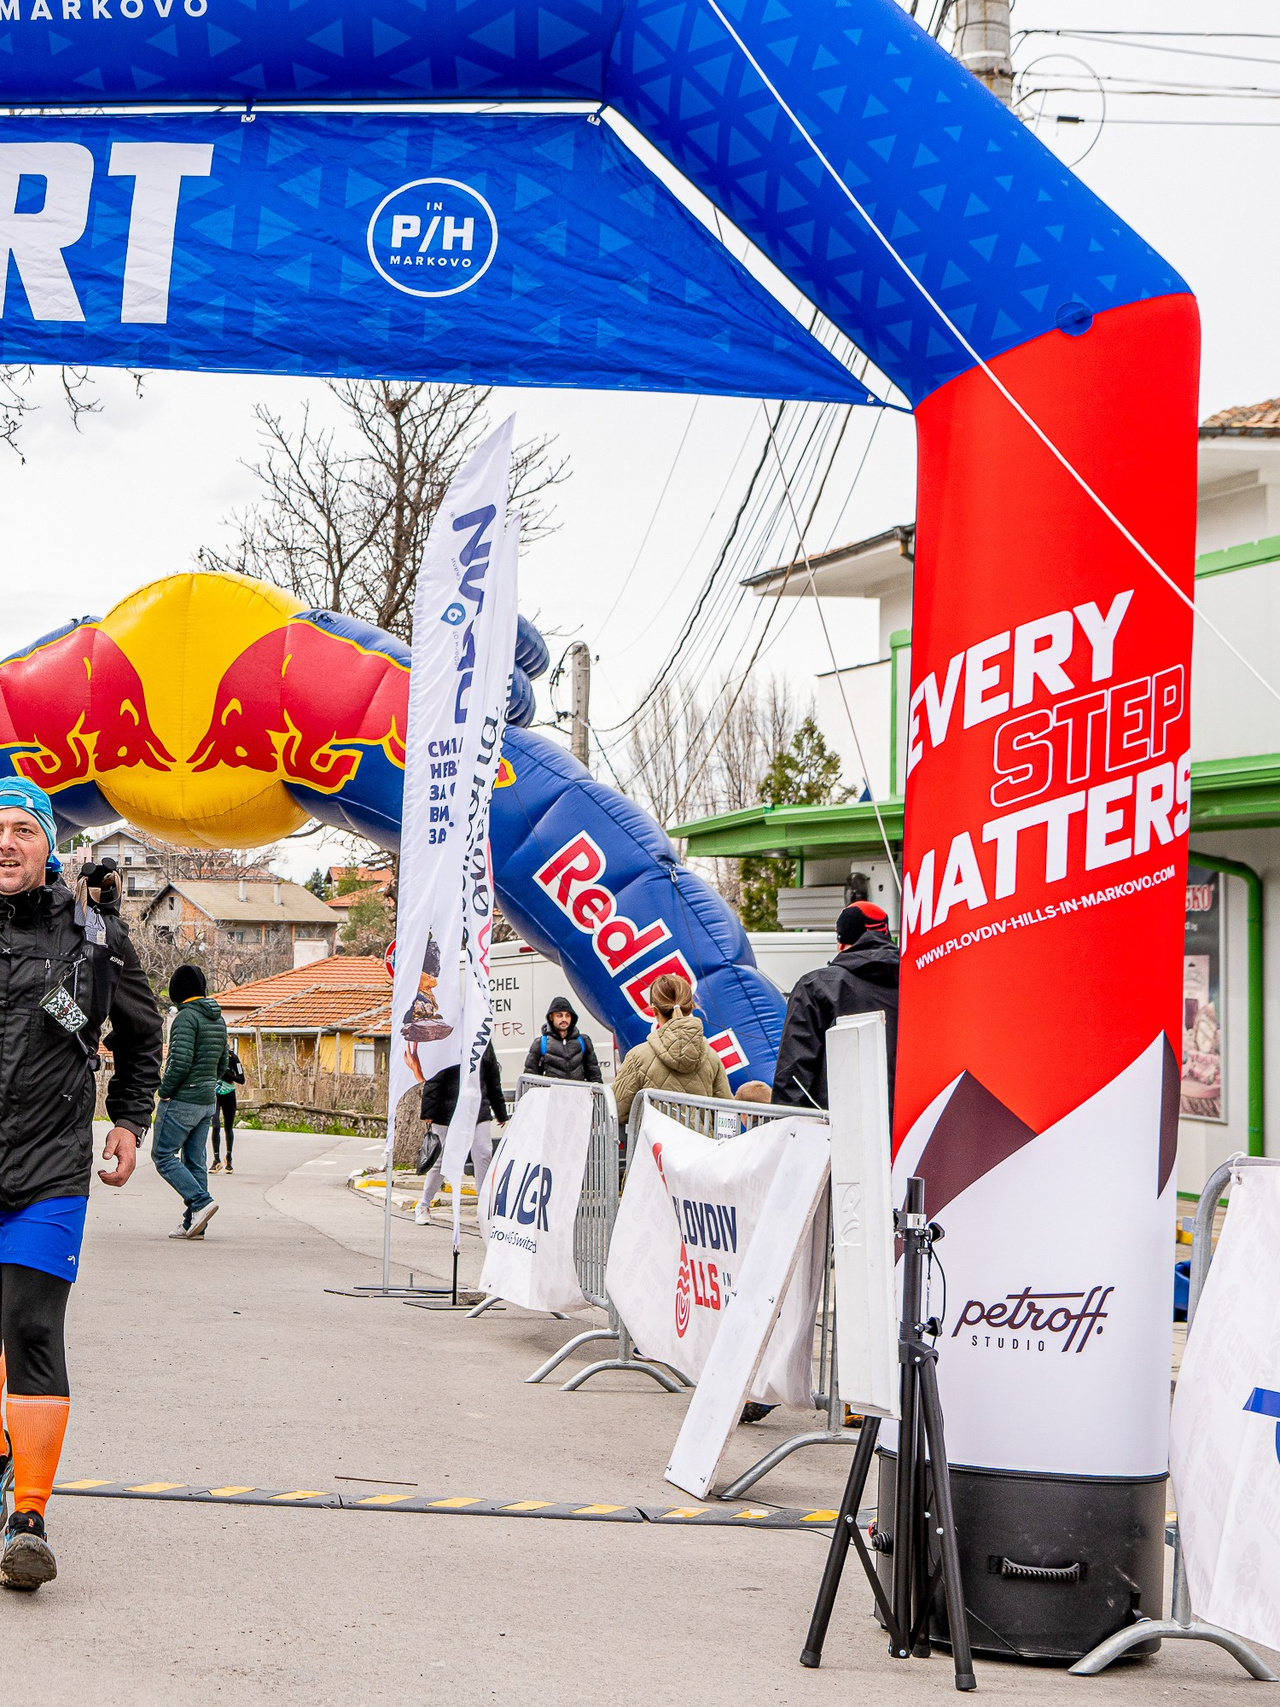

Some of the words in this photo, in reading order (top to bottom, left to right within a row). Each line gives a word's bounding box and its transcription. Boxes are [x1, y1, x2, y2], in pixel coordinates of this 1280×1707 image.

[426, 202, 443, 211] IN
[391, 214, 474, 253] P/H
[389, 255, 472, 268] MARKOVO
[907, 588, 1135, 779] EVERY
[990, 663, 1185, 808] STEP
[901, 747, 1191, 957] MATTERS
[538, 837, 665, 970] Red
[915, 864, 1176, 970] WWW.PLOVDIV-HILLS-IN-MARKOVO.COM
[489, 977, 520, 992] CHEL
[689, 1259, 721, 1311] LLS
[971, 1335, 1045, 1352] STUDIO
